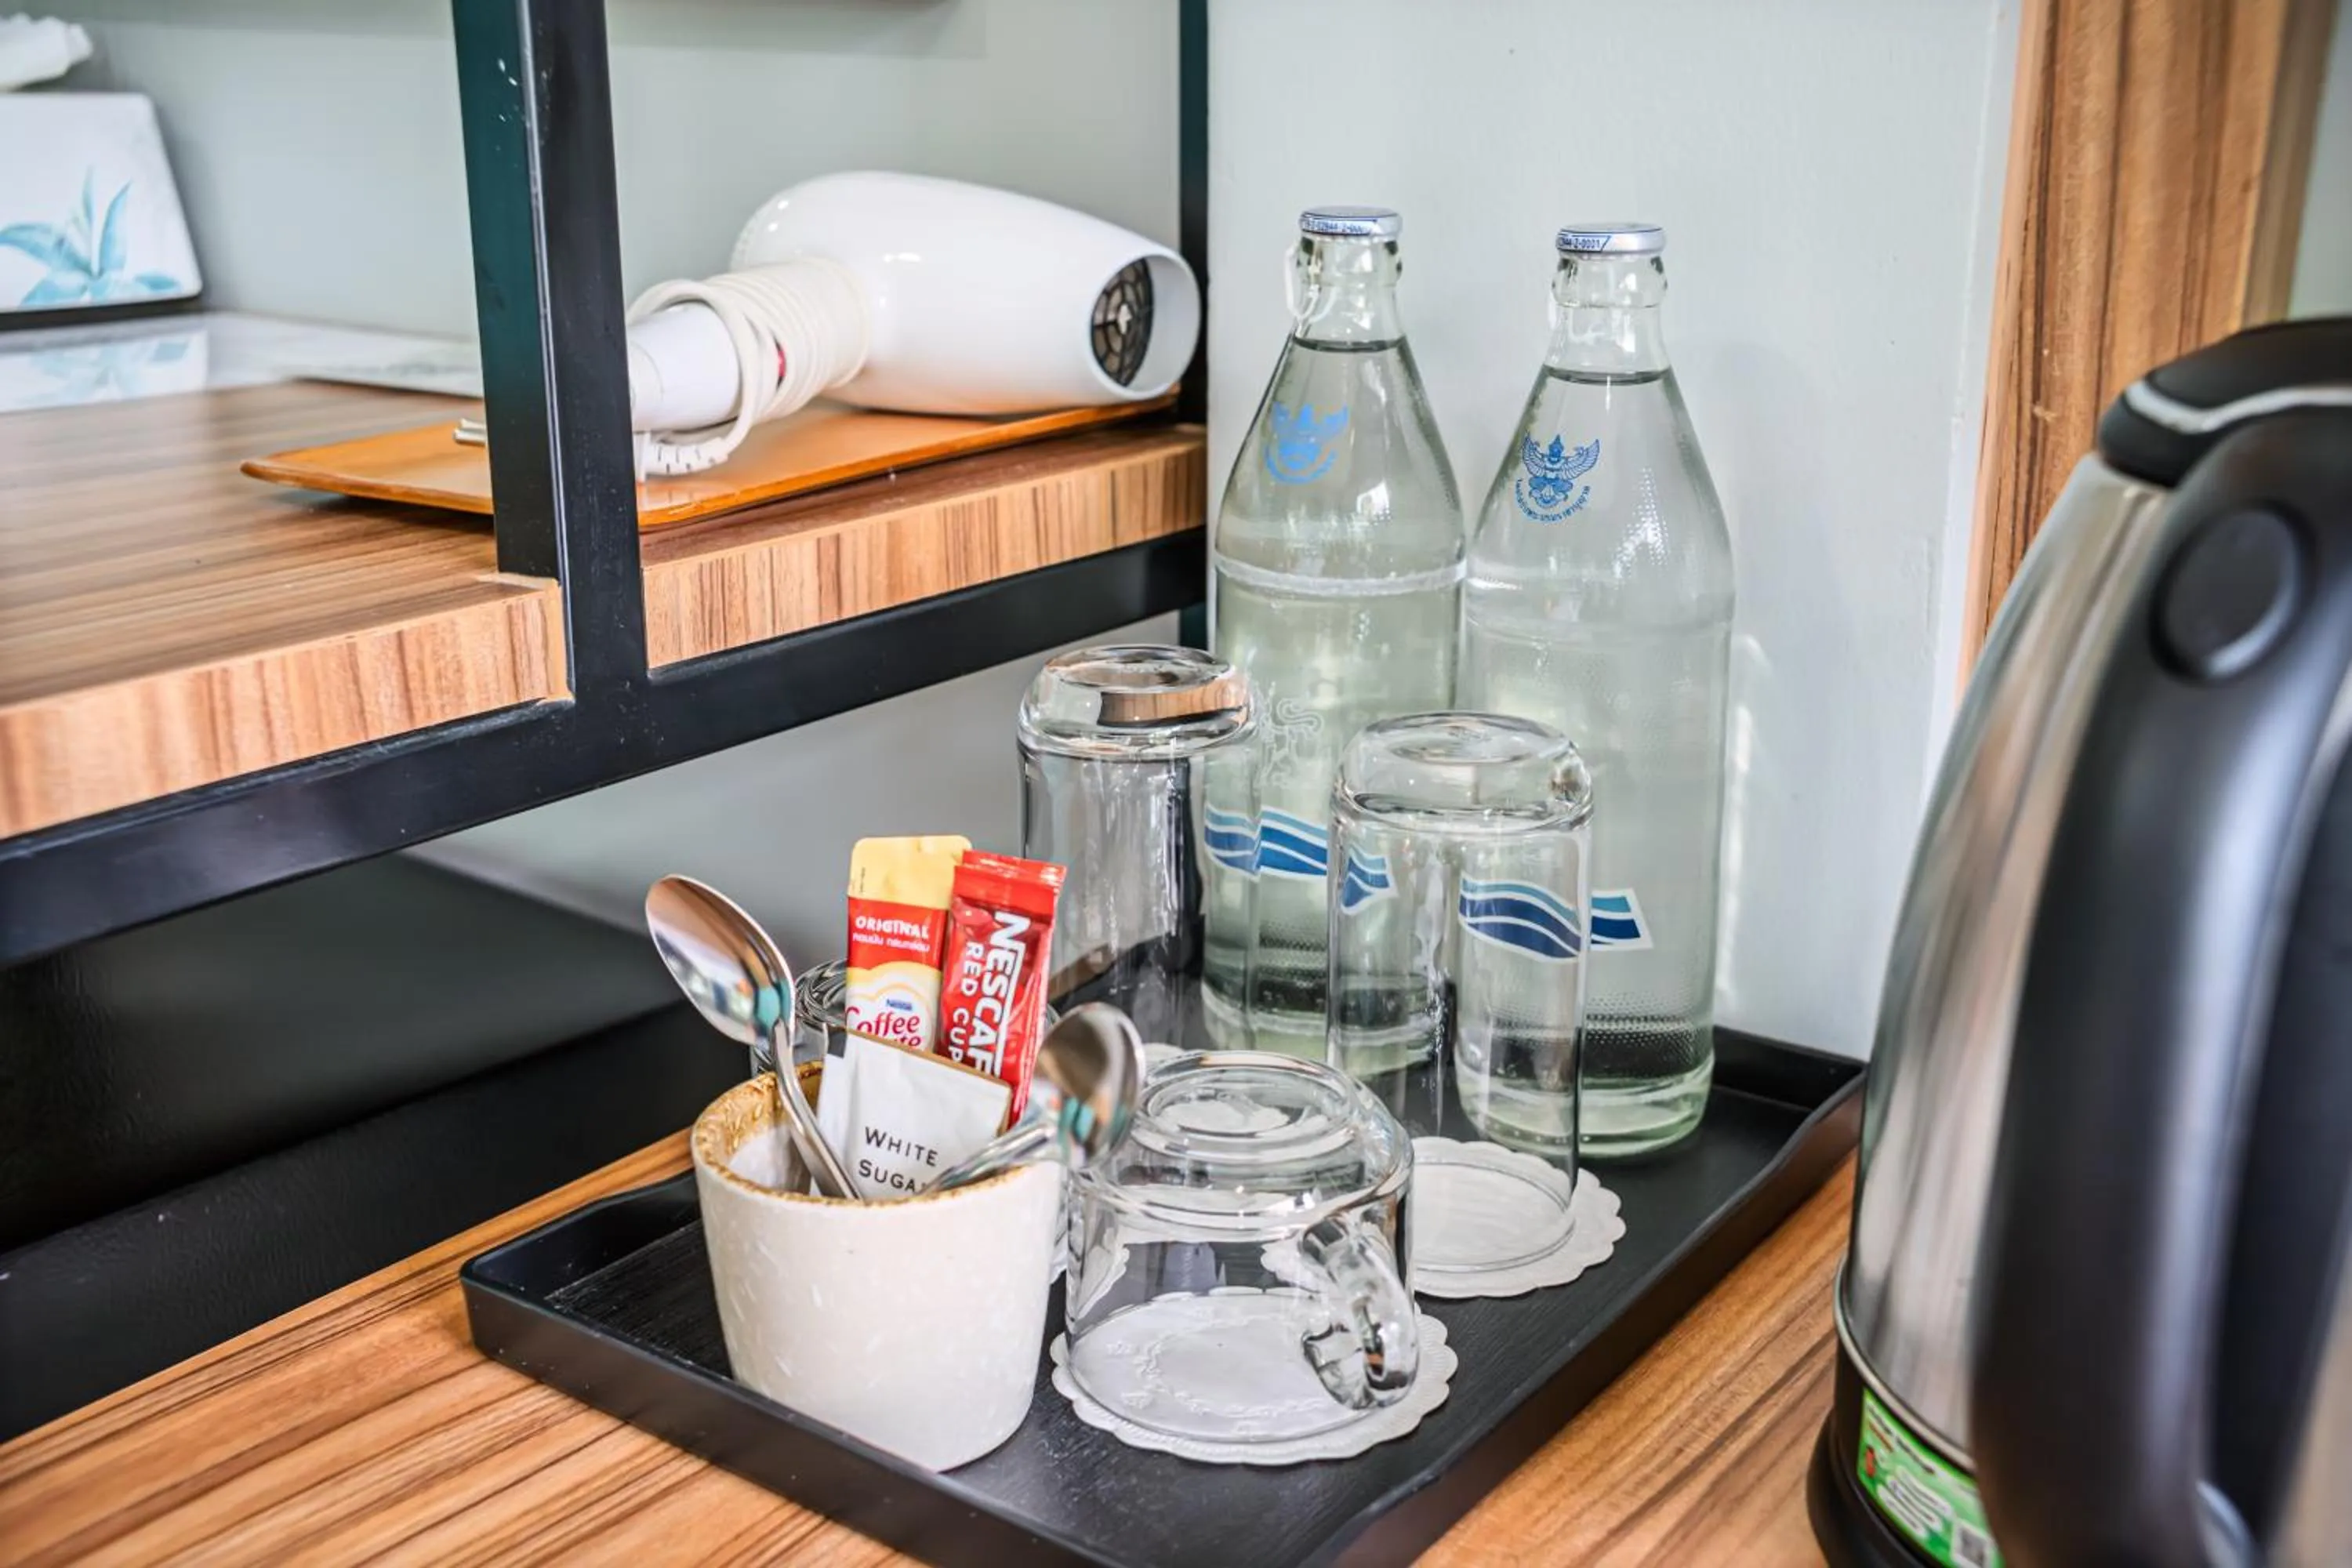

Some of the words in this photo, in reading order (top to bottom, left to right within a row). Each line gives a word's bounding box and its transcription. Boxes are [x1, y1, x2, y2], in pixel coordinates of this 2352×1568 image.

[855, 916, 929, 939] ORIGINAL
[960, 942, 984, 997] RED
[967, 910, 1031, 1077] NESCAF
[945, 1007, 970, 1063] CUP
[865, 1126, 938, 1167] WHITE
[858, 1159, 928, 1192] SUGA
